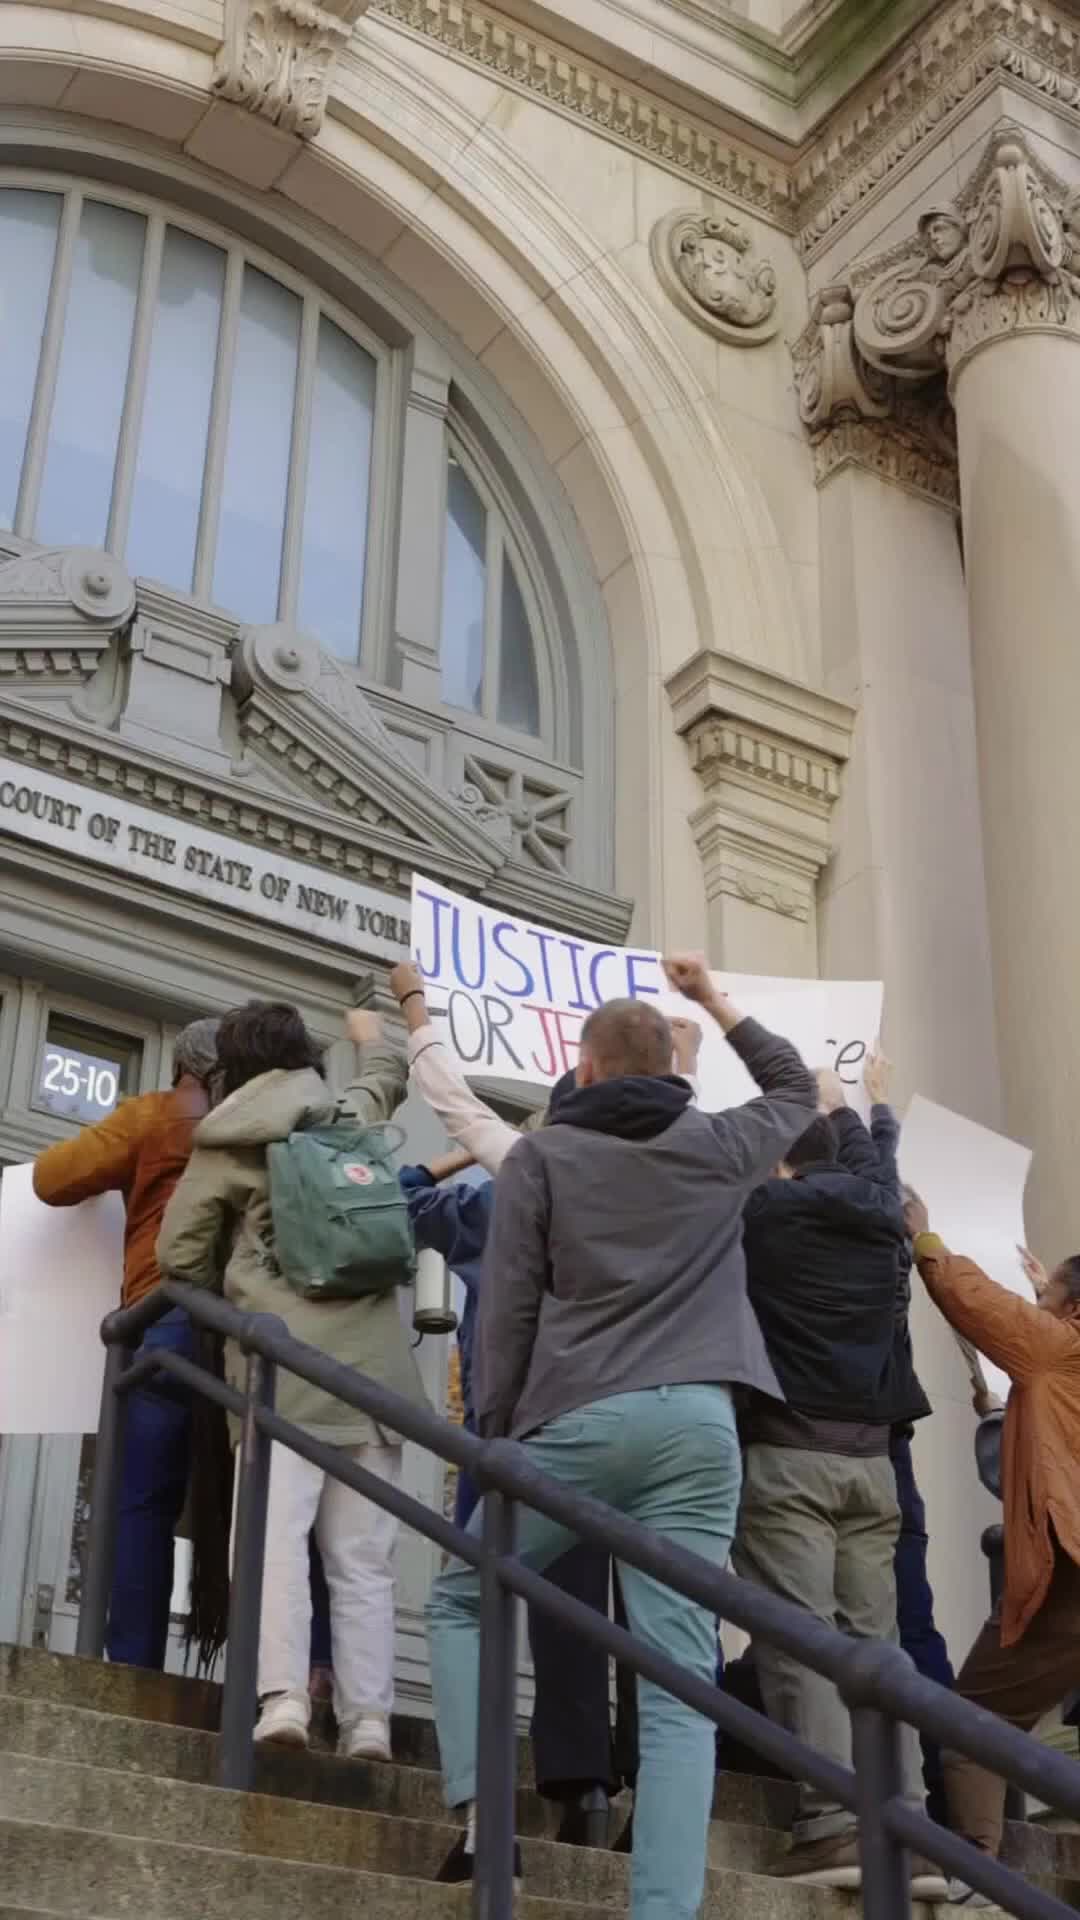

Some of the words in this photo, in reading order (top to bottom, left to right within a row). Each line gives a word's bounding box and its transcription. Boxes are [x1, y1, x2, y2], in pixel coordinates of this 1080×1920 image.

[0, 781, 82, 831] COURT
[87, 813, 120, 844] OF
[128, 825, 177, 865] THE
[184, 845, 253, 892] STATE
[260, 873, 291, 903] OF
[296, 885, 349, 922] NEW
[416, 889, 660, 1011] JUSTICE
[44, 1054, 117, 1107] 25-10
